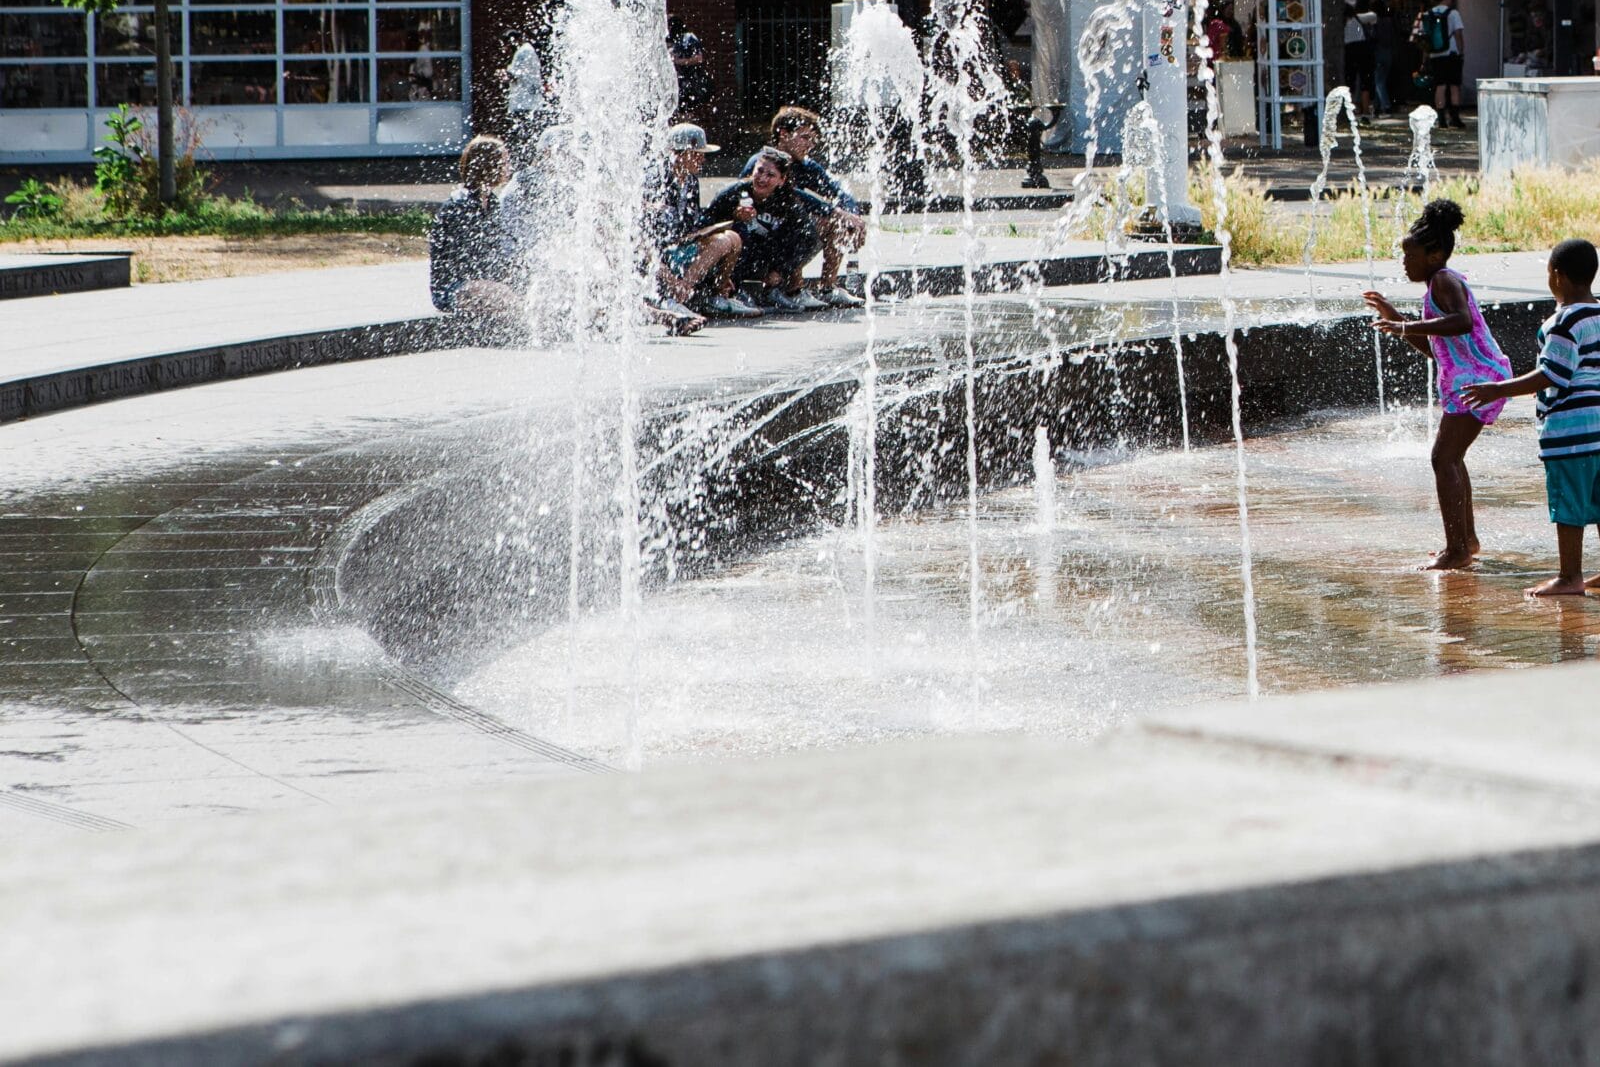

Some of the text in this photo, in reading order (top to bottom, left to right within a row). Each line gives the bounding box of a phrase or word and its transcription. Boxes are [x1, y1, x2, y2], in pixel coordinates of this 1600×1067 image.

[42, 268, 84, 288] BANKS
[49, 381, 61, 403] IN
[65, 373, 97, 400] CIVIC
[100, 367, 134, 392] CLUBS
[165, 351, 226, 380] SOCIETIES
[241, 344, 288, 370] HOUSES
